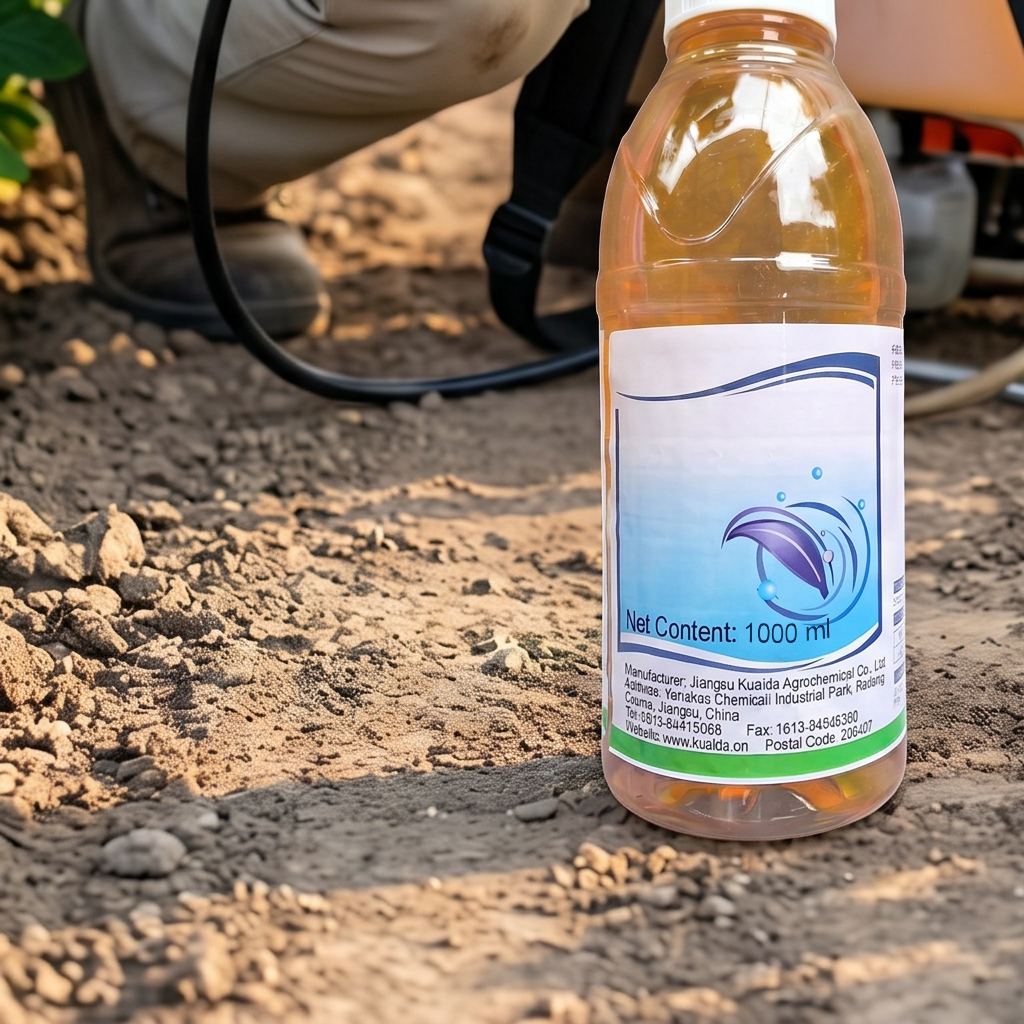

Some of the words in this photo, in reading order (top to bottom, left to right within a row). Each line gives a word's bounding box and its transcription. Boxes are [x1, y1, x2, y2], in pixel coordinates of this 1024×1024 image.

[626, 608, 650, 635] Net
[655, 615, 737, 643] Content:
[745, 622, 798, 644] 1000
[806, 617, 830, 642] ml
[690, 675, 735, 693] Jiangsu
[738, 678, 780, 691] Kuaida
[857, 664, 872, 678] Co.
[775, 687, 825, 705] Industrial
[658, 701, 702, 721] Jiangsu,
[705, 707, 740, 722] China
[746, 723, 773, 737] Fax:
[765, 736, 802, 752] Postal
